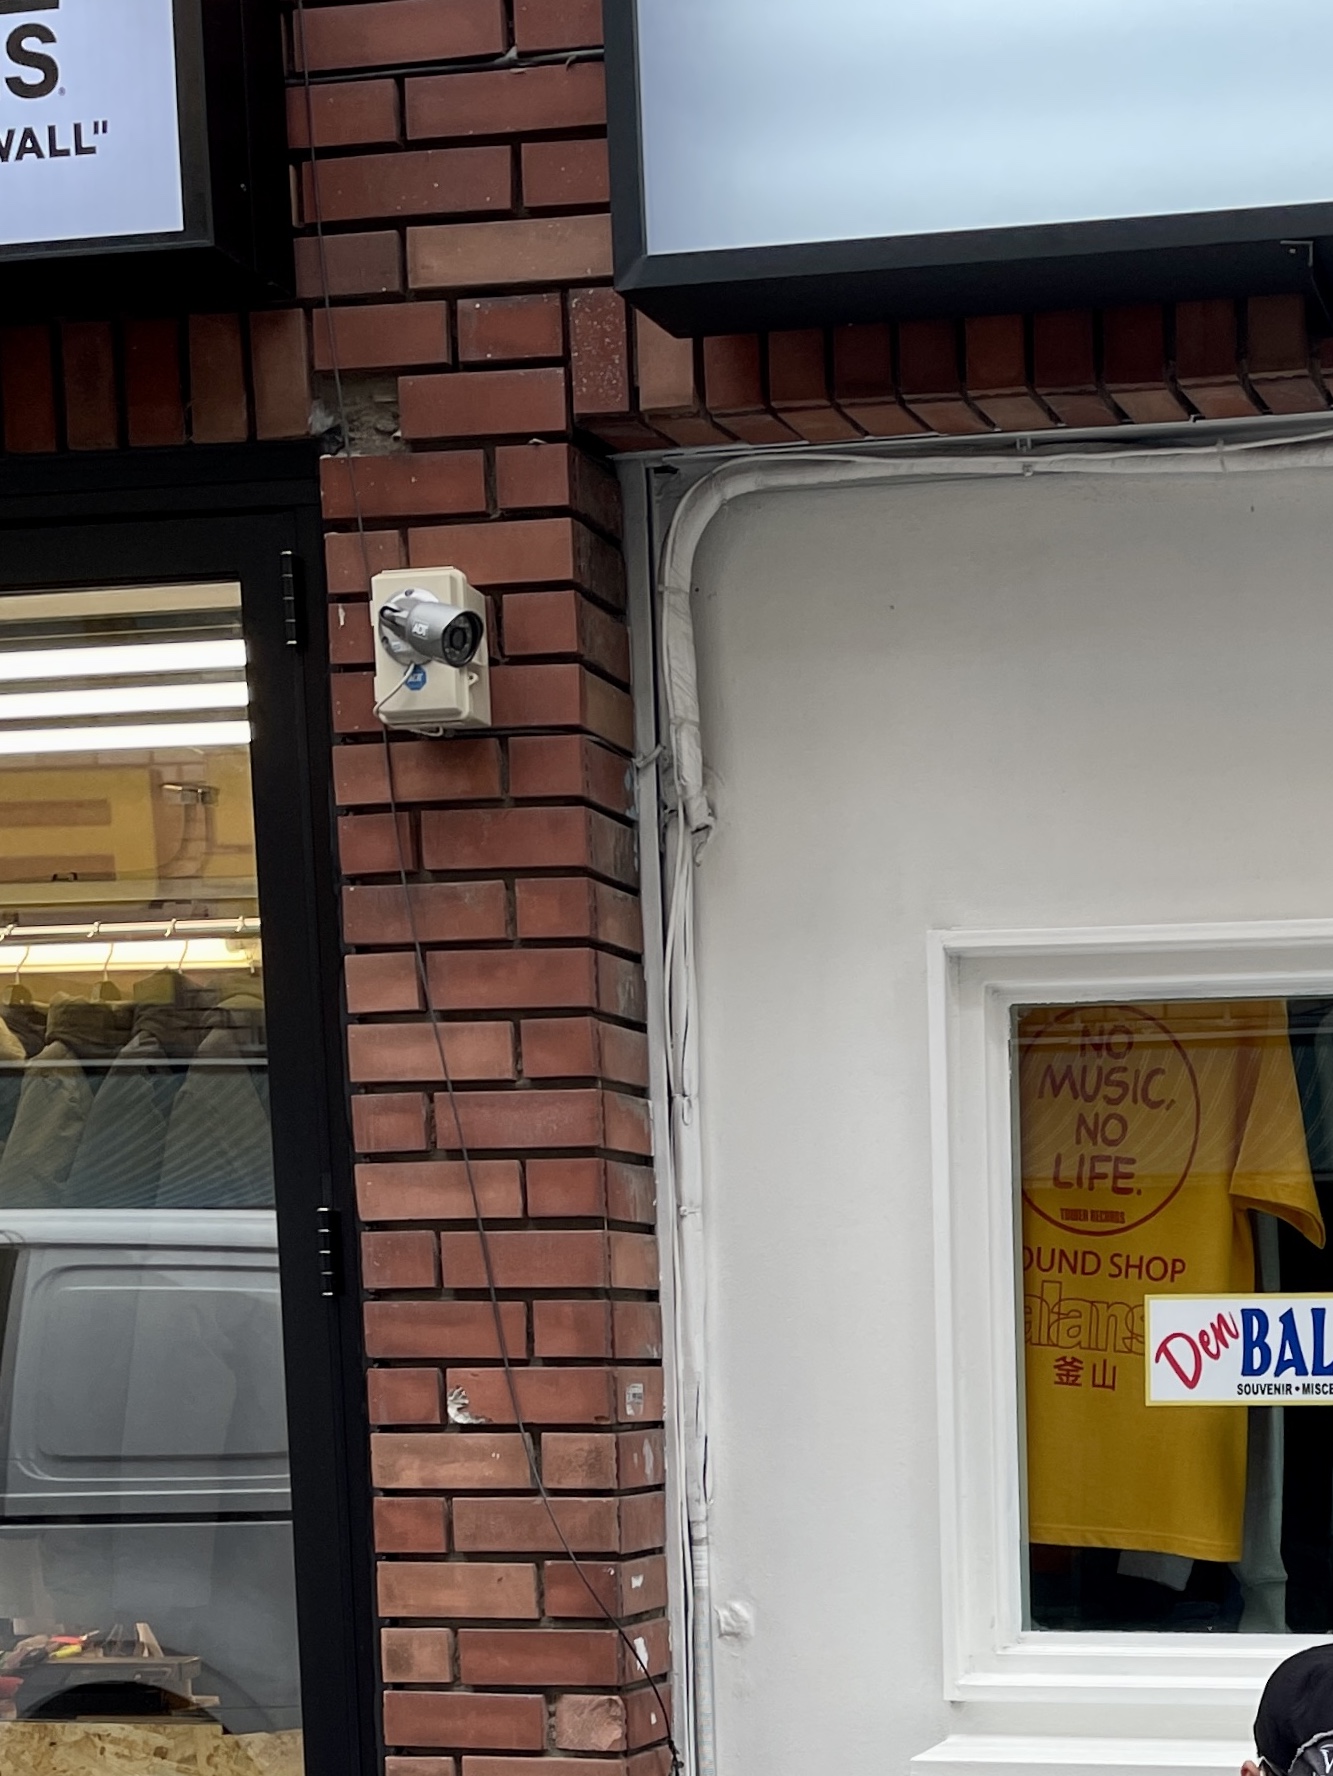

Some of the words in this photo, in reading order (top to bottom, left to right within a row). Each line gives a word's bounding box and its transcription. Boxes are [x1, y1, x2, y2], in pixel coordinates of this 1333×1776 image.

[5, 22, 59, 99] S
[1080, 1025, 1134, 1060] NO
[1037, 1064, 1177, 1112] MUSIC,
[1075, 1112, 1129, 1147] NO
[1052, 1152, 1143, 1197] LIFE.
[1109, 1251, 1187, 1283] SHOP
[1155, 1311, 1240, 1390] Den
[1236, 1383, 1293, 1396] SOUVENIR
